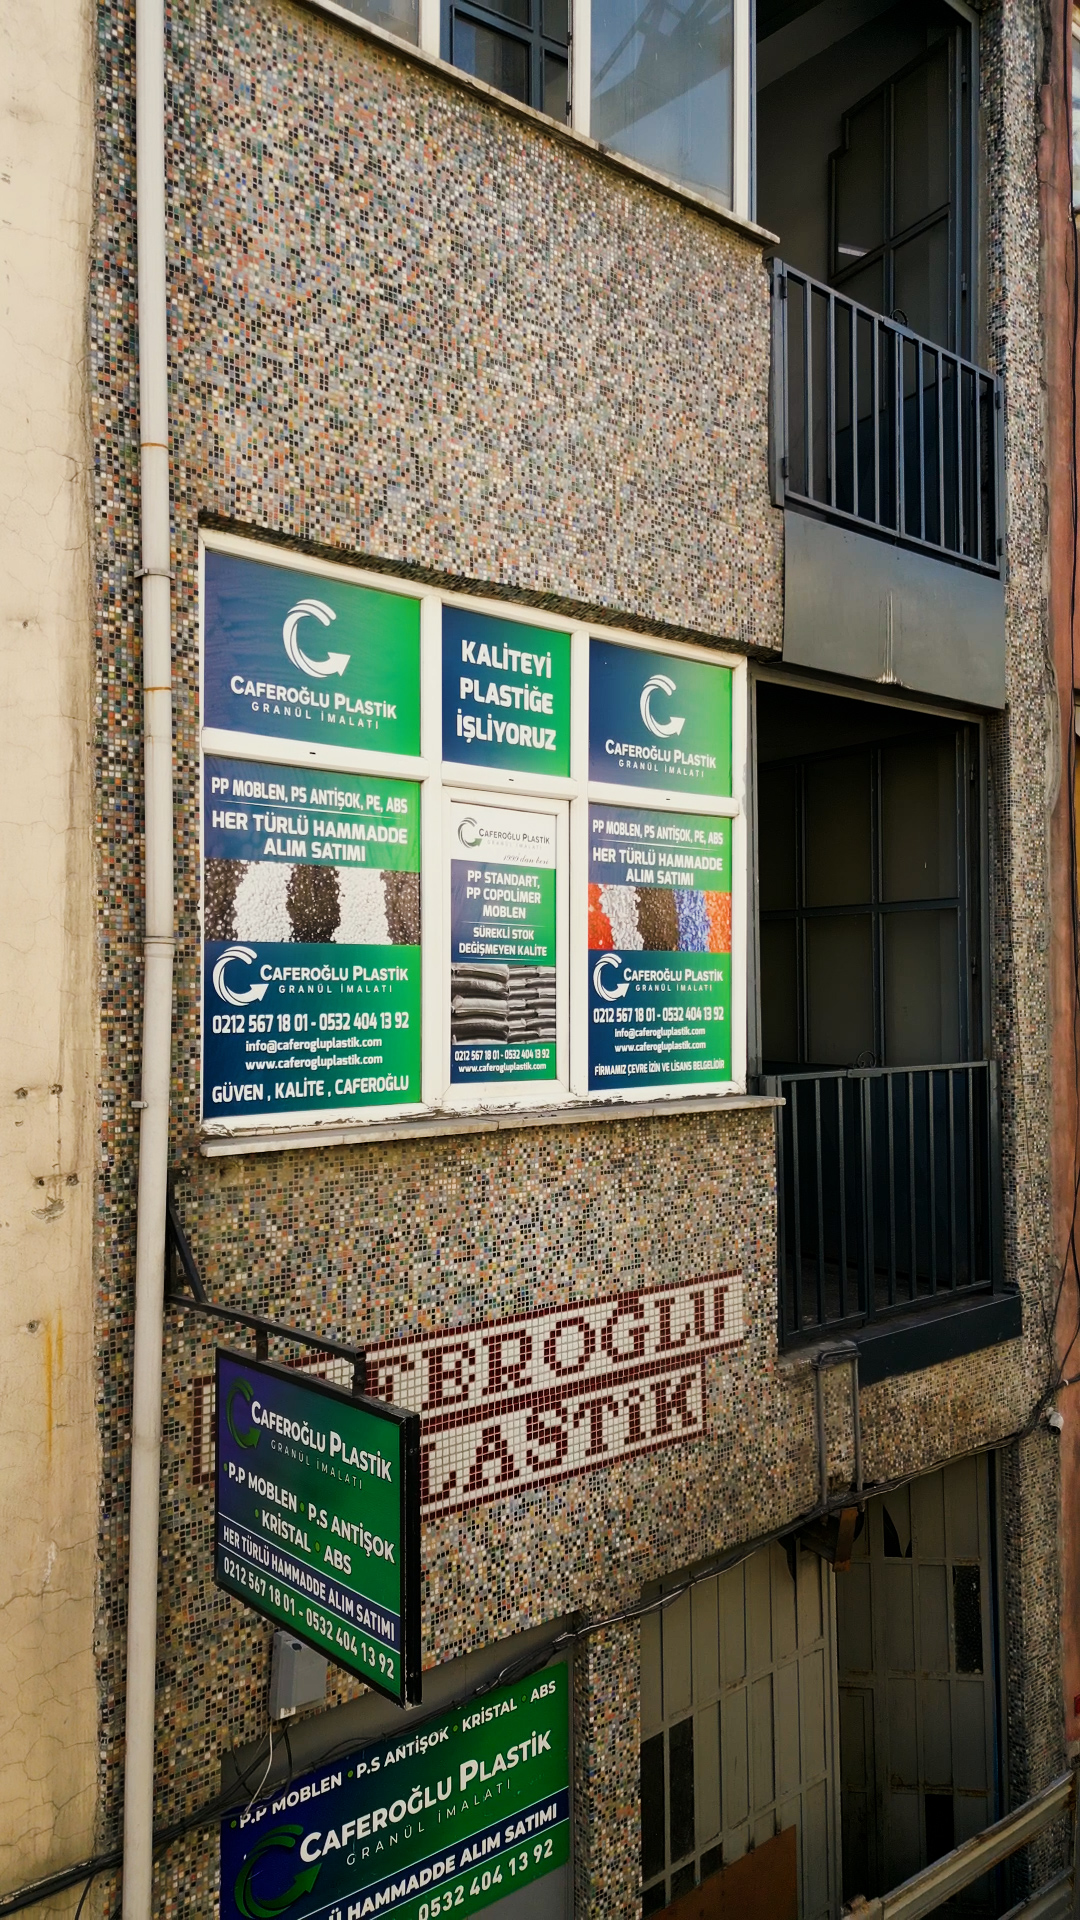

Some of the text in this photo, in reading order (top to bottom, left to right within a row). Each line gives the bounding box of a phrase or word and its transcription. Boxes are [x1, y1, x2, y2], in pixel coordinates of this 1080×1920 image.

[461, 639, 552, 679] KALİTEYİ
[230, 675, 397, 719] CAFEROĞLU PLASTİK
[459, 676, 554, 715] PLASTİĞE
[251, 701, 379, 730] GRANÜL İMALATI
[456, 708, 557, 751] İŞLİYORUZ
[605, 739, 717, 769] CAFEROĞLU PLASTİK
[618, 759, 659, 772] GRANÜL
[211, 776, 229, 795] PP
[232, 779, 288, 803] MOBLEN,
[291, 785, 307, 804] PS
[366, 794, 383, 813] PE,
[386, 798, 408, 814] ABS
[211, 810, 408, 845] HER TÜRLÜ HAMMADDE
[478, 828, 521, 841] CAFEROĞLU
[592, 819, 604, 833] PP
[606, 821, 642, 838] MOBLEN,
[644, 824, 655, 839] PS
[694, 830, 706, 845] PE,
[708, 831, 723, 845] ABS
[263, 838, 366, 862] ALIM SATIMI
[592, 846, 723, 871] HER TÜRLÜ HAMMADDE
[467, 870, 540, 889] PP STANDART,
[625, 868, 694, 886] ALIM SATIMI
[466, 887, 541, 904] PP COPOLİMER
[482, 904, 526, 919] MOBLEN
[473, 925, 534, 940] SÜREKLİ STOK
[459, 942, 547, 956] DEĞİŞMEYEN KALİTE
[260, 964, 409, 981] CAFEROĞLU PLASTİK
[623, 967, 723, 982] CAFEROĞLU PLASTİK
[278, 983, 392, 994] GRANÜL İMALATI
[635, 983, 671, 992] GRANÜL
[212, 1014, 245, 1034] 0212
[248, 1014, 274, 1033] 567
[277, 1013, 291, 1032] 18
[294, 1013, 308, 1032] 01
[319, 1012, 350, 1031] 0532
[353, 1012, 377, 1030] 404
[380, 1012, 391, 1029] 13
[395, 1011, 409, 1029] 92
[593, 1007, 615, 1023] 0212
[616, 1007, 633, 1023] 567
[635, 1007, 644, 1022] 18
[645, 1007, 656, 1022] 01
[662, 1007, 684, 1021] 0532
[685, 1006, 702, 1021] 404
[703, 1006, 712, 1021] 13
[713, 1006, 724, 1020] 92
[614, 1026, 706, 1039] info@caferogluplastik.com
[245, 1037, 382, 1054] info@caferogluplastik.com
[454, 1050, 470, 1061] 0212
[471, 1050, 483, 1060] 567
[492, 1050, 500, 1060] 01
[504, 1049, 520, 1060] 0532
[521, 1049, 534, 1059] 404
[542, 1048, 550, 1059] 92
[614, 1040, 706, 1053] www.caferogluplastik.com
[245, 1054, 383, 1071] www.caferogluplastik.com
[458, 1062, 547, 1073] www.caferogluplastik.com
[627, 1063, 648, 1076] ÇEVRE
[661, 1062, 670, 1072] VE
[670, 1059, 691, 1072] LİSANS
[211, 1081, 264, 1103] GÜVEN
[275, 1077, 325, 1099] KALİTE
[334, 1072, 409, 1095] CAFEROĞLU
[251, 1400, 392, 1482] CAFEROĞLU PLASTİK
[270, 1439, 310, 1466] GRANÜL
[228, 1461, 395, 1564] P.P MOBLEN P.S ANTİŞOK
[261, 1509, 352, 1575] KRİSTAL ABS
[223, 1525, 395, 1642] HER TÜRLÜ HAMMADDE ALIM SATIMI
[223, 1556, 247, 1586] 0212
[248, 1571, 266, 1597] 567
[269, 1584, 281, 1607] 18
[283, 1593, 295, 1617] 01
[306, 1607, 334, 1641] 0532
[335, 1627, 358, 1656] 404
[361, 1641, 376, 1667] 13
[379, 1652, 395, 1680] 92
[272, 1771, 342, 1815] MOBLEN
[356, 1756, 381, 1779] P.S
[462, 1698, 518, 1732] KRİSTAL
[530, 1680, 556, 1703] ABS
[299, 1729, 552, 1863] CAFEROĞLU PLASTİK
[346, 1821, 425, 1866] GRANÜL
[347, 1802, 557, 1920] HAMMADDE ALIM SATIMI
[418, 1838, 553, 1920] 0532 404 13 92
